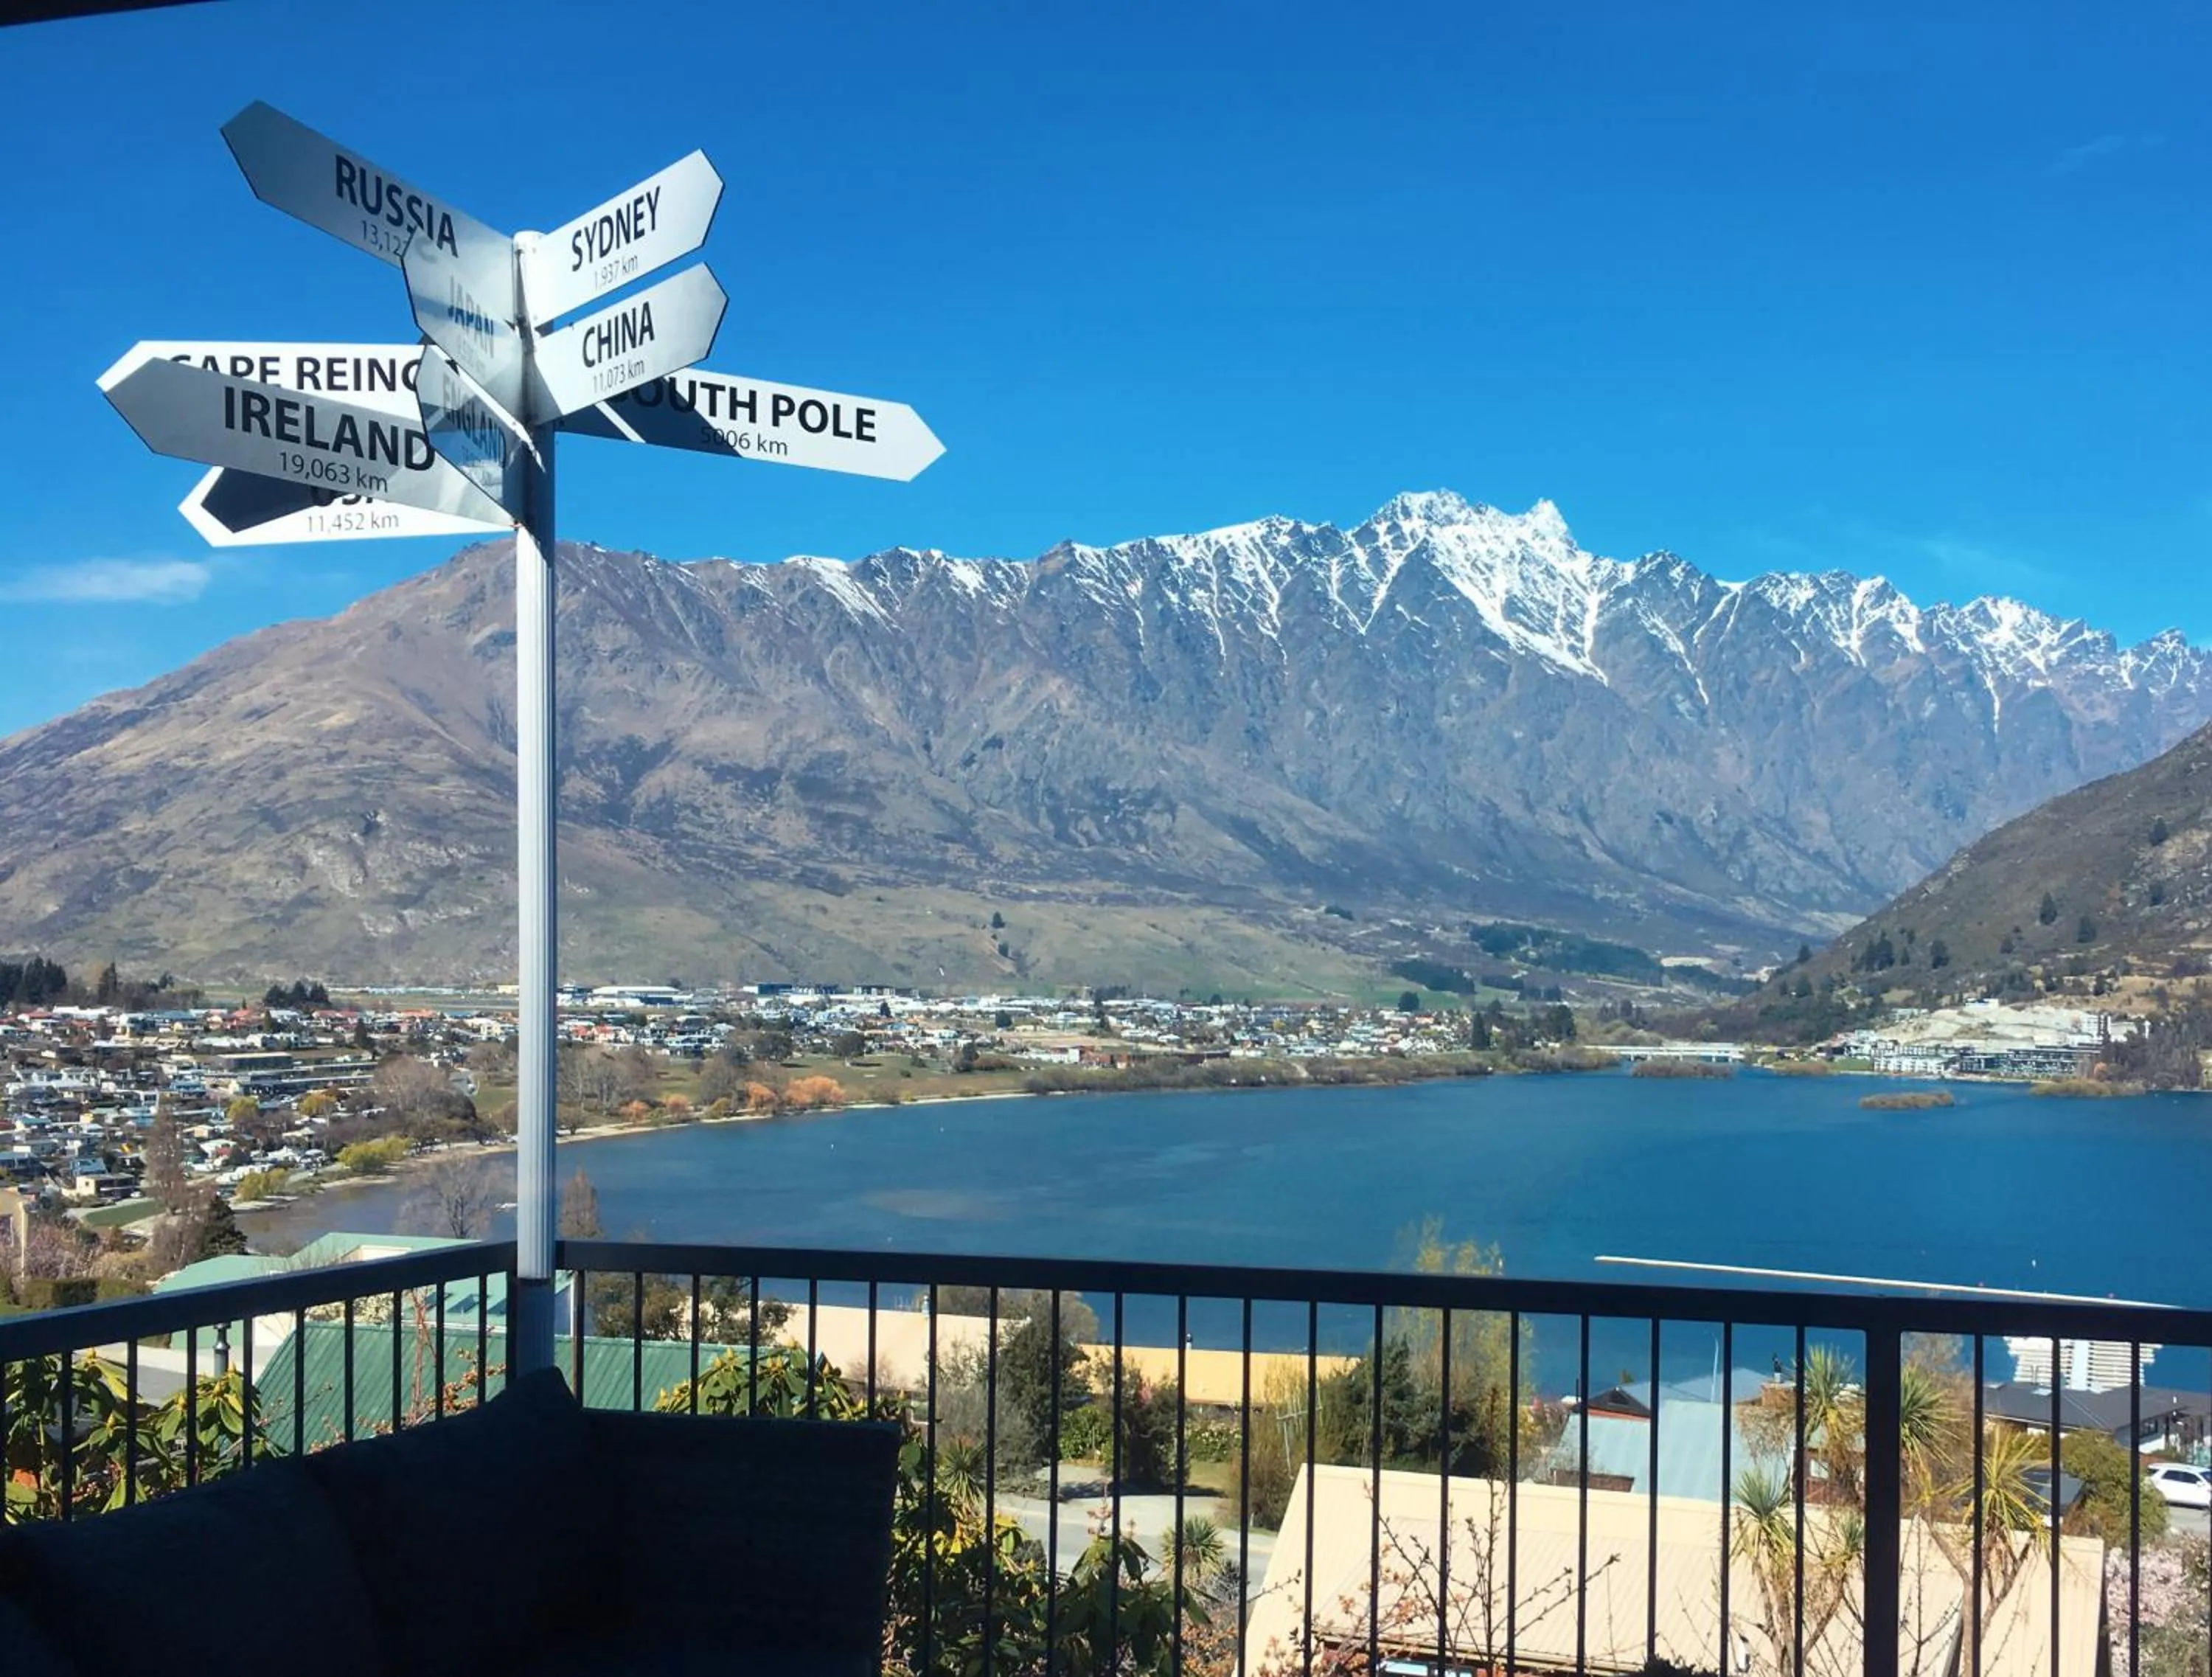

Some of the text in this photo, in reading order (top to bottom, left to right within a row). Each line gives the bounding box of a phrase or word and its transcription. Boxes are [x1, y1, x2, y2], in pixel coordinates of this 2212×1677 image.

[335, 155, 458, 257] RUSSIA
[361, 220, 408, 258] 13,12
[571, 186, 661, 272] SYDNEY
[622, 254, 638, 276] km
[448, 274, 495, 359] JAPAN
[582, 301, 655, 368] CHINA
[170, 355, 459, 392] PE REIN
[627, 359, 645, 380] km
[224, 386, 436, 472] IRELAND
[609, 377, 877, 443] OUTH POLE
[701, 426, 788, 456] 5006 km
[279, 451, 388, 493] 19,063 km
[307, 512, 399, 535] 11,452 km
